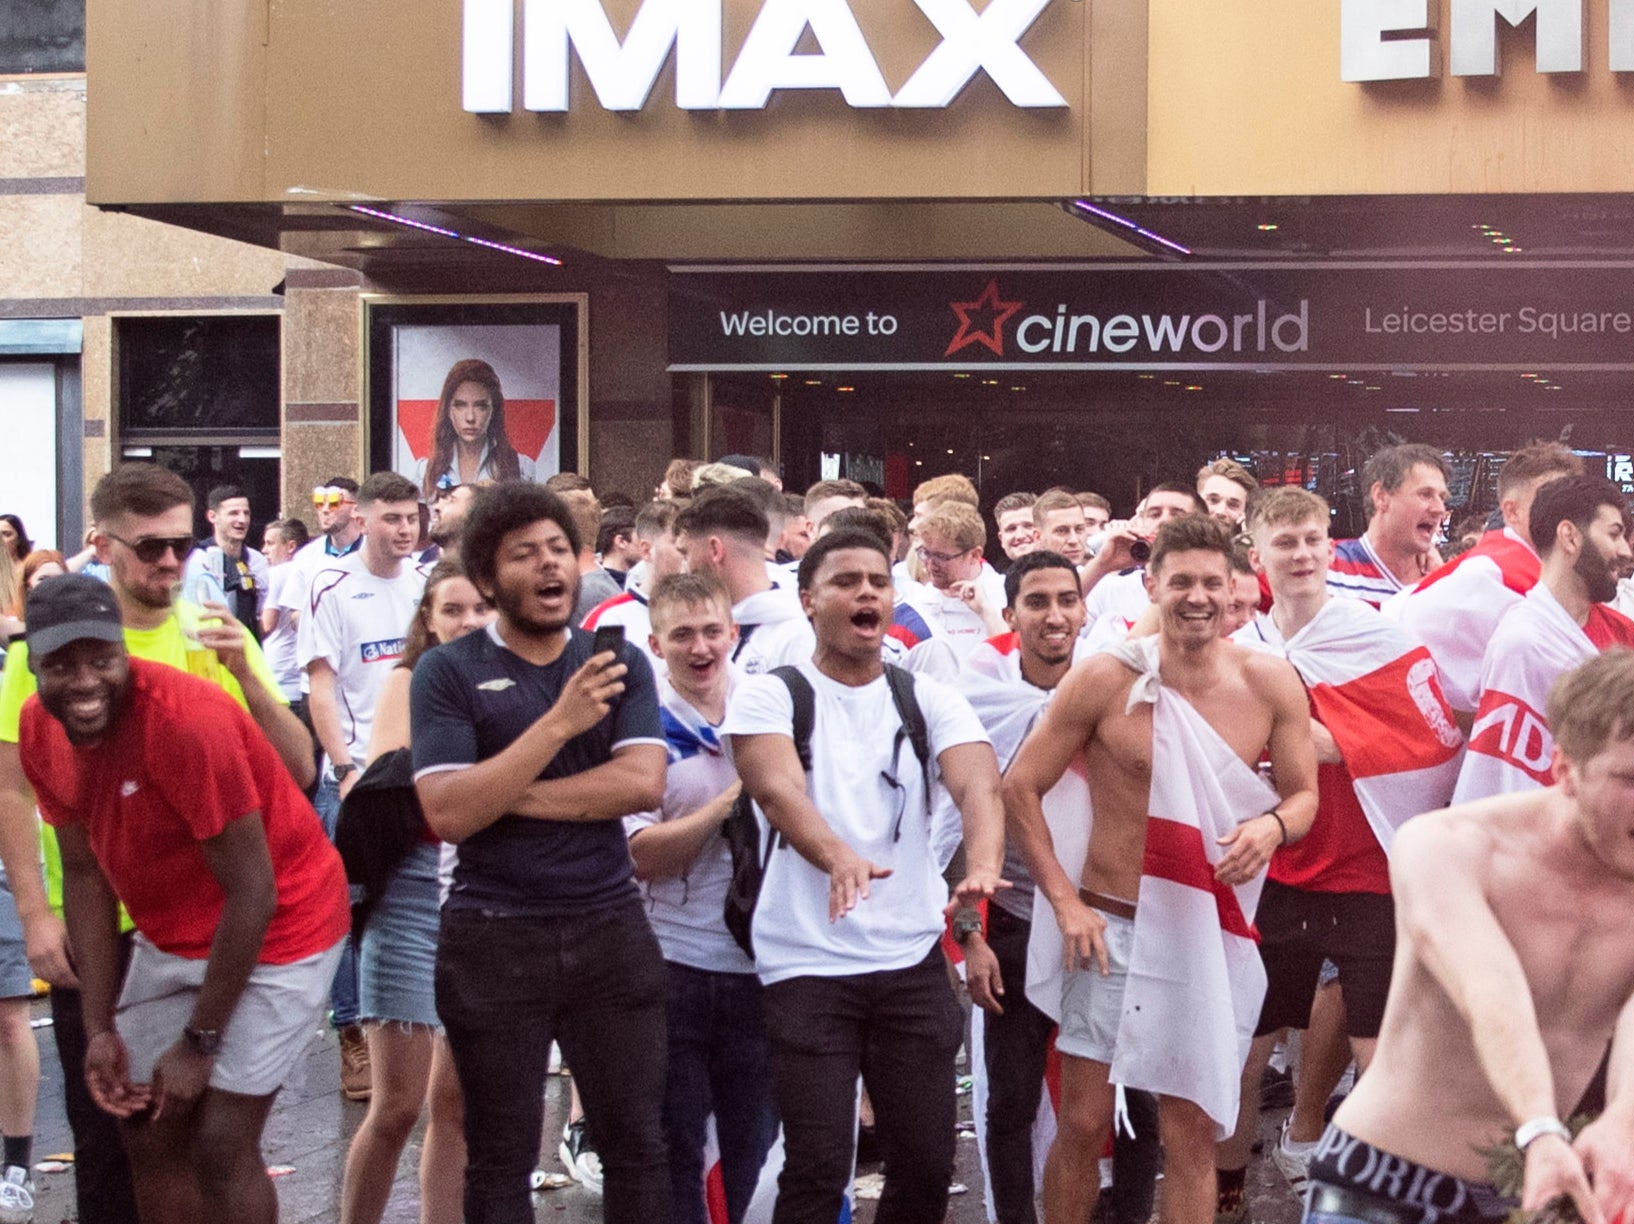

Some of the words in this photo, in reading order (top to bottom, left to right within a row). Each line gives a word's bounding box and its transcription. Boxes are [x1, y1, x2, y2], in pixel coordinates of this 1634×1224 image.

[461, 0, 1070, 112] IMAX
[720, 309, 859, 336] Welcome
[865, 311, 898, 336] to
[1016, 299, 1309, 353] cineworld
[1364, 306, 1512, 334] Leicester
[1518, 307, 1632, 339] Square
